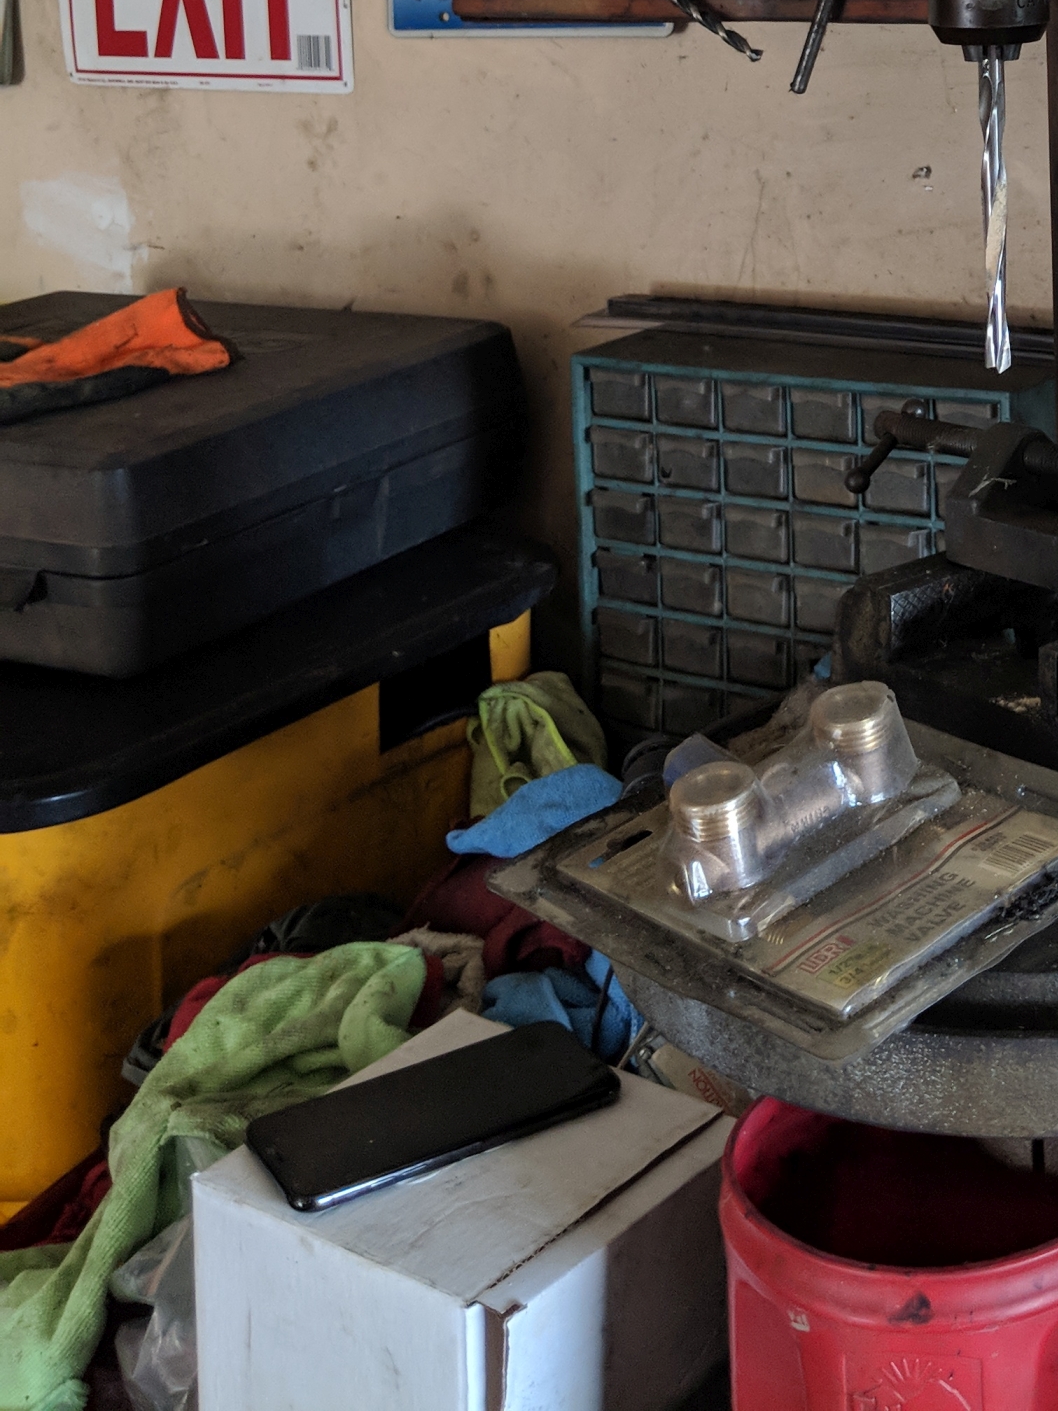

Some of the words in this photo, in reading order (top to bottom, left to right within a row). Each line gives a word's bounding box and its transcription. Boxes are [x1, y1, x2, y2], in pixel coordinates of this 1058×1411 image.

[867, 871, 959, 928] WASHING
[885, 878, 976, 937] MACHINE
[907, 901, 967, 942] VALVE
